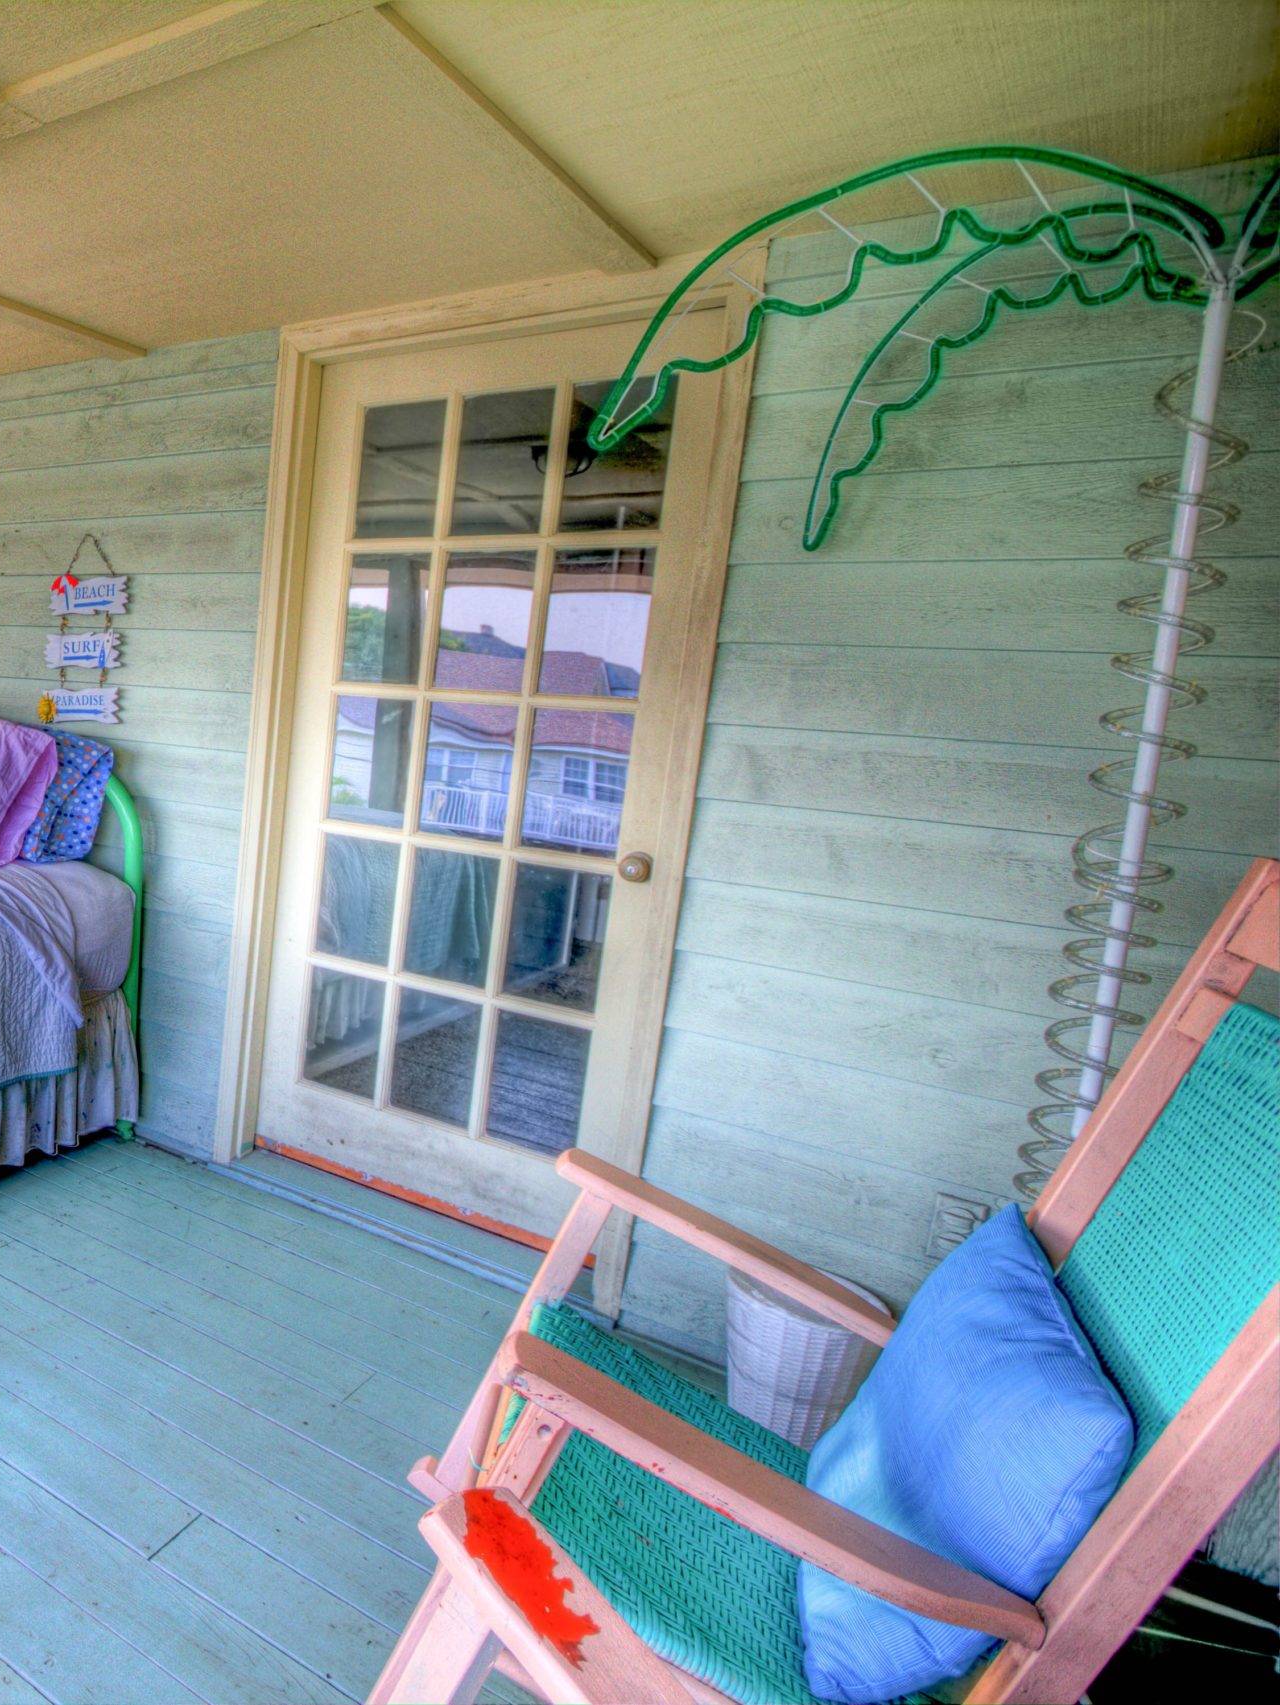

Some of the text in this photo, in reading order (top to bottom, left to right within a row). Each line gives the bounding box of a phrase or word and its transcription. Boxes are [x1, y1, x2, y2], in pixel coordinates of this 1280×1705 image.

[74, 583, 115, 600] BEACH
[63, 639, 100, 654] SURF
[55, 694, 105, 706] PARADISE
